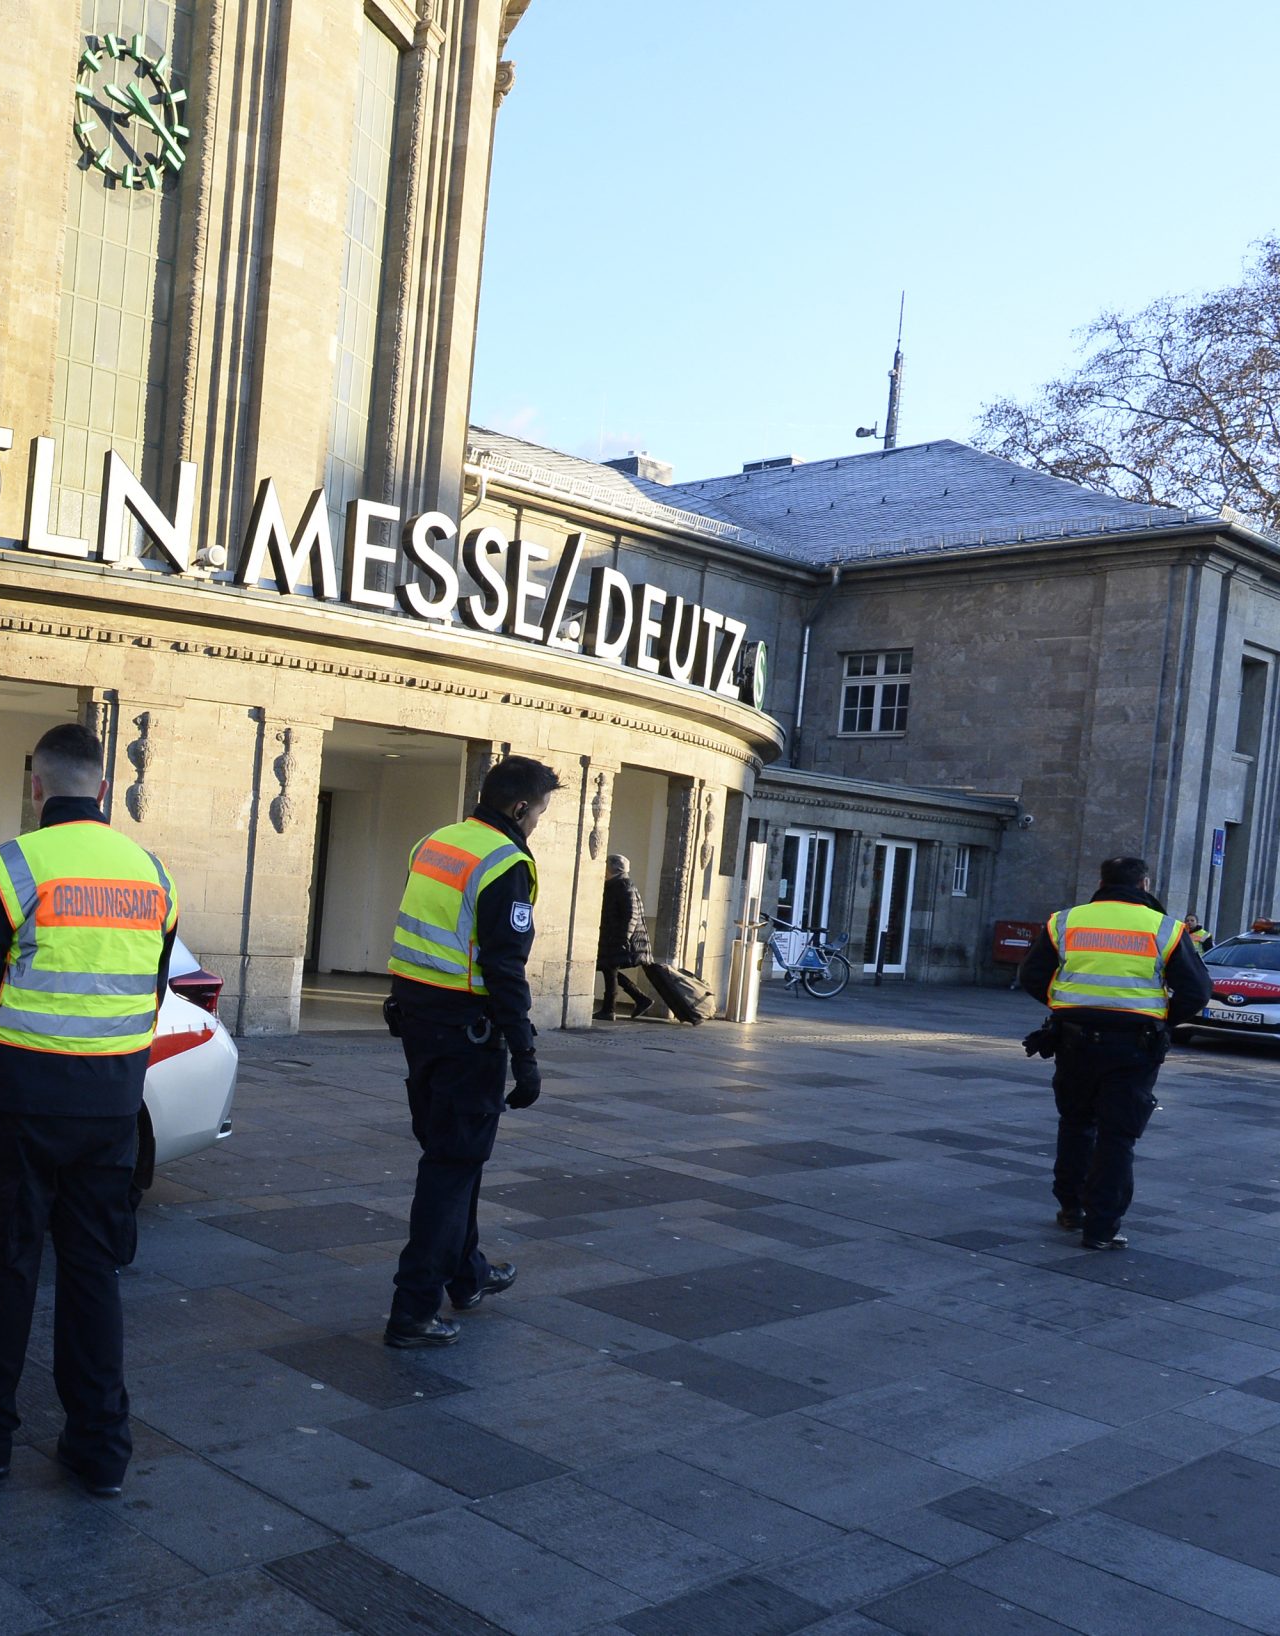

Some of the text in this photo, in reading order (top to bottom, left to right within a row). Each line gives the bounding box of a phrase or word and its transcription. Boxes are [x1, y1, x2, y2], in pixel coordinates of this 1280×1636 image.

[53, 885, 159, 920] ORDNUNGSAMT
[1071, 931, 1149, 953] ORDNUNGSAMT
[1209, 1010, 1218, 1018] K
